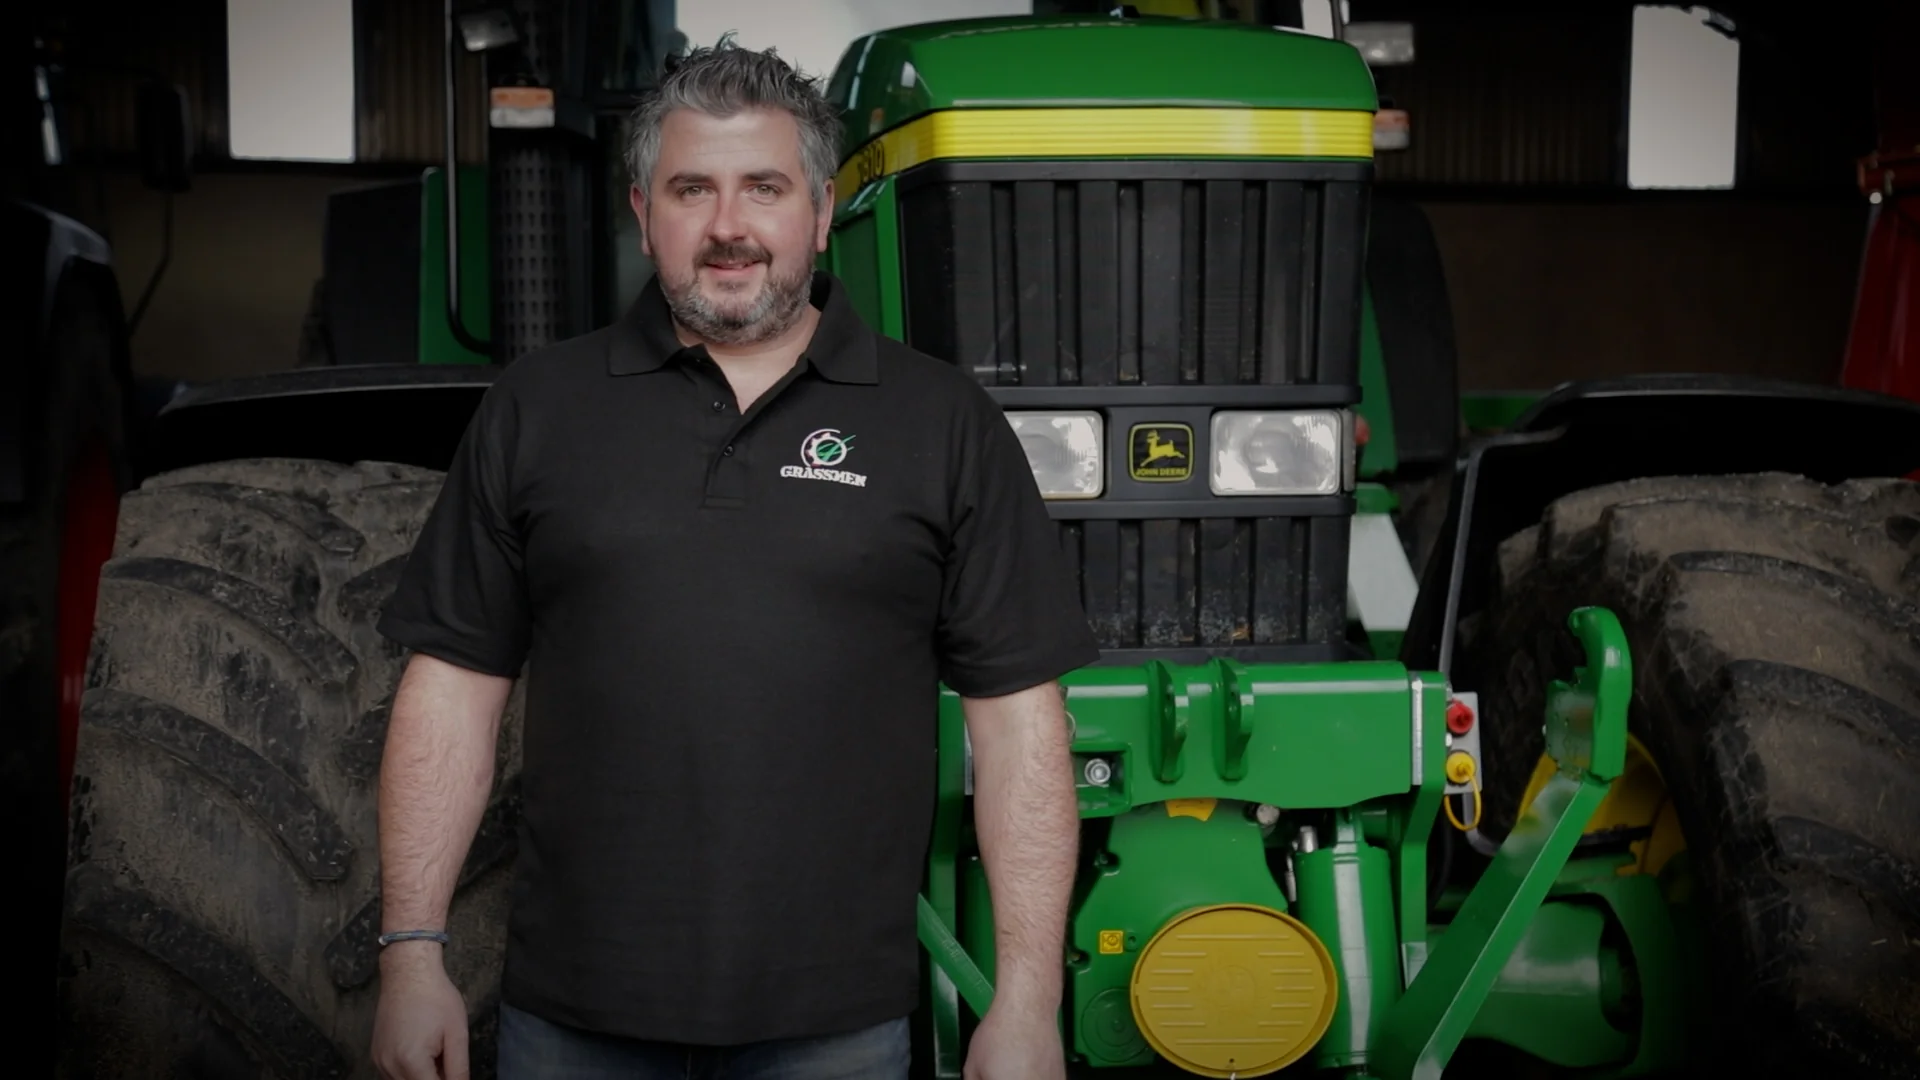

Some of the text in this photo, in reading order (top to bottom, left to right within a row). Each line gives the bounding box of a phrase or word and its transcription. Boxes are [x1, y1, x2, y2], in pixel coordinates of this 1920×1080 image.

[780, 465, 867, 487] GRASSMEN
[1135, 467, 1187, 477] JOHN DEERE
